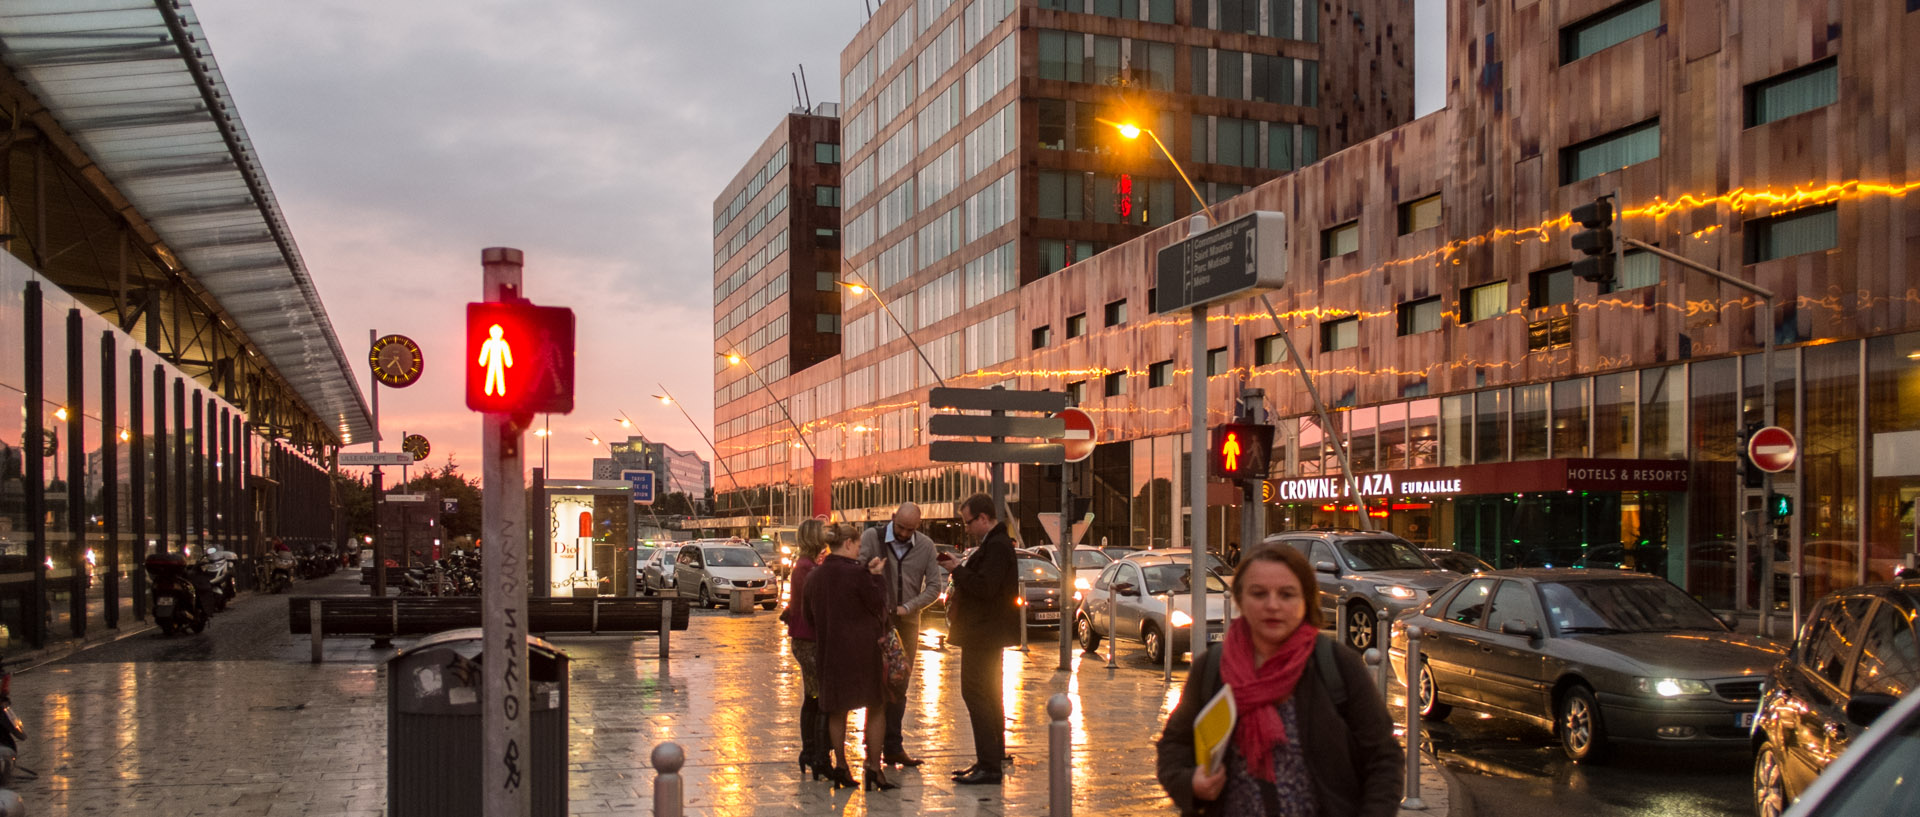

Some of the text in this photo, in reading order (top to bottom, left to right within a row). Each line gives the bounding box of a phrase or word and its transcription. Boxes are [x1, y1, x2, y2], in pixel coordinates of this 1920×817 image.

[1194, 241, 1233, 262] Saint Maurice
[1194, 256, 1231, 275] Parc Matisse
[1568, 468, 1688, 481] HOTELS & RESORTS
[1279, 477, 1339, 500] CROWNE
[1401, 479, 1462, 494] EURALILLE
[554, 541, 580, 554] Dior
